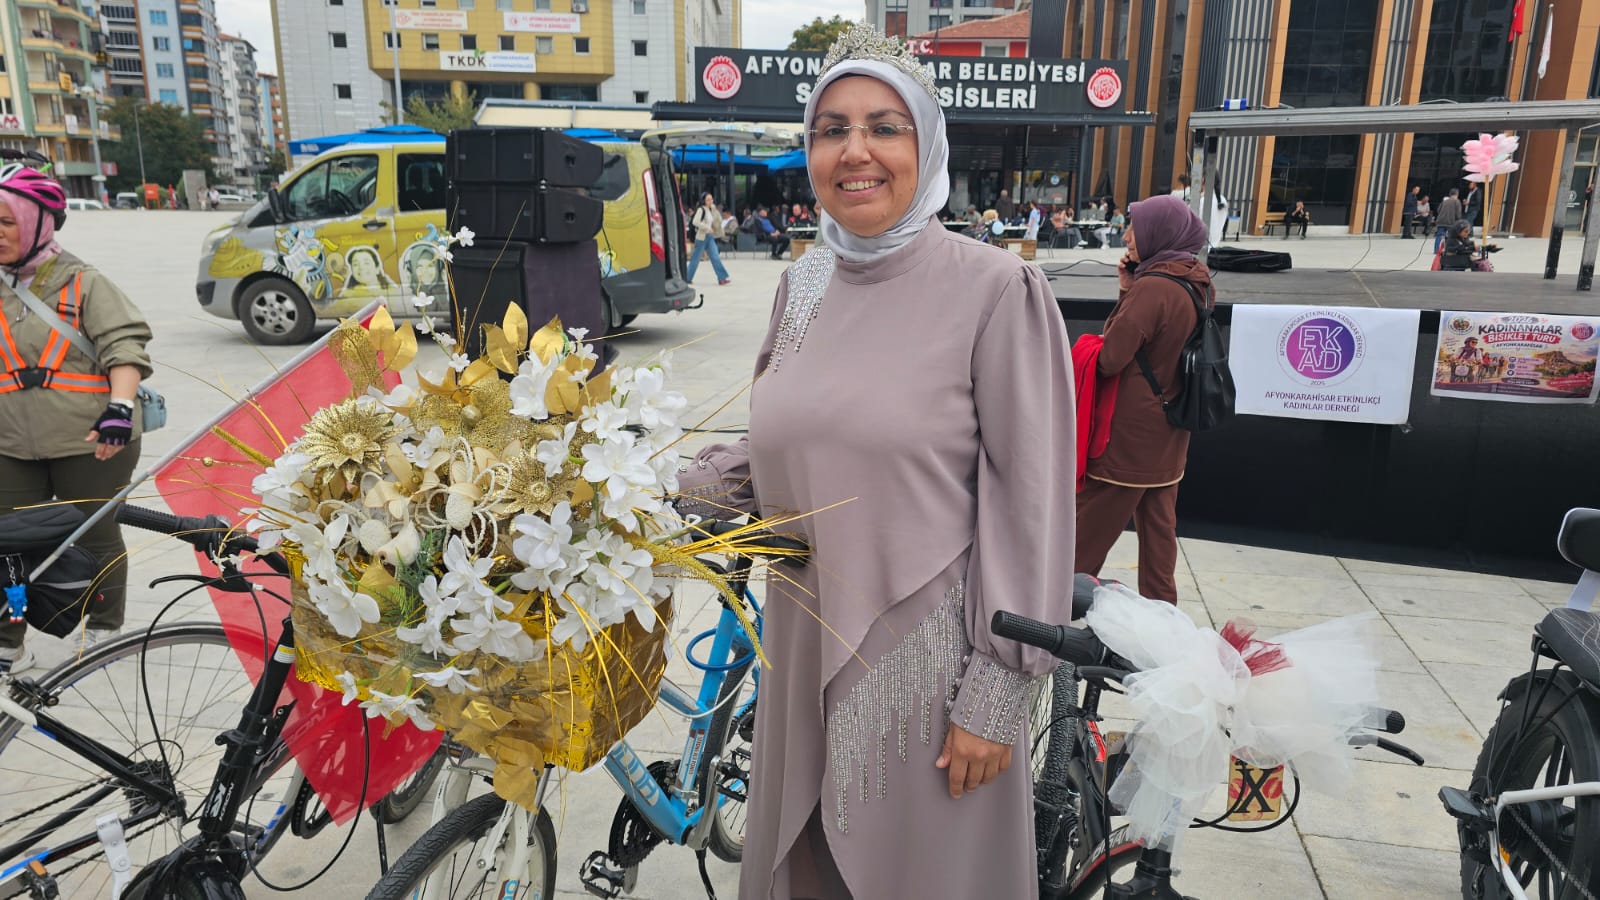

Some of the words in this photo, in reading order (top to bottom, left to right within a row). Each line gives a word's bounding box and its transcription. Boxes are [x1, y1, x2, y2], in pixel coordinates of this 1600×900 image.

[448, 55, 486, 67] TKDK
[959, 58, 1086, 83] BELEDİYESİ
[938, 83, 1037, 109] SİSLERİ
[1478, 324, 1562, 335] KADINANALAR
[1265, 391, 1336, 403] AFYONKARAHİSAR
[1337, 395, 1381, 405] ETKİNLİKÇİ
[1283, 401, 1324, 411] KADINLAR
